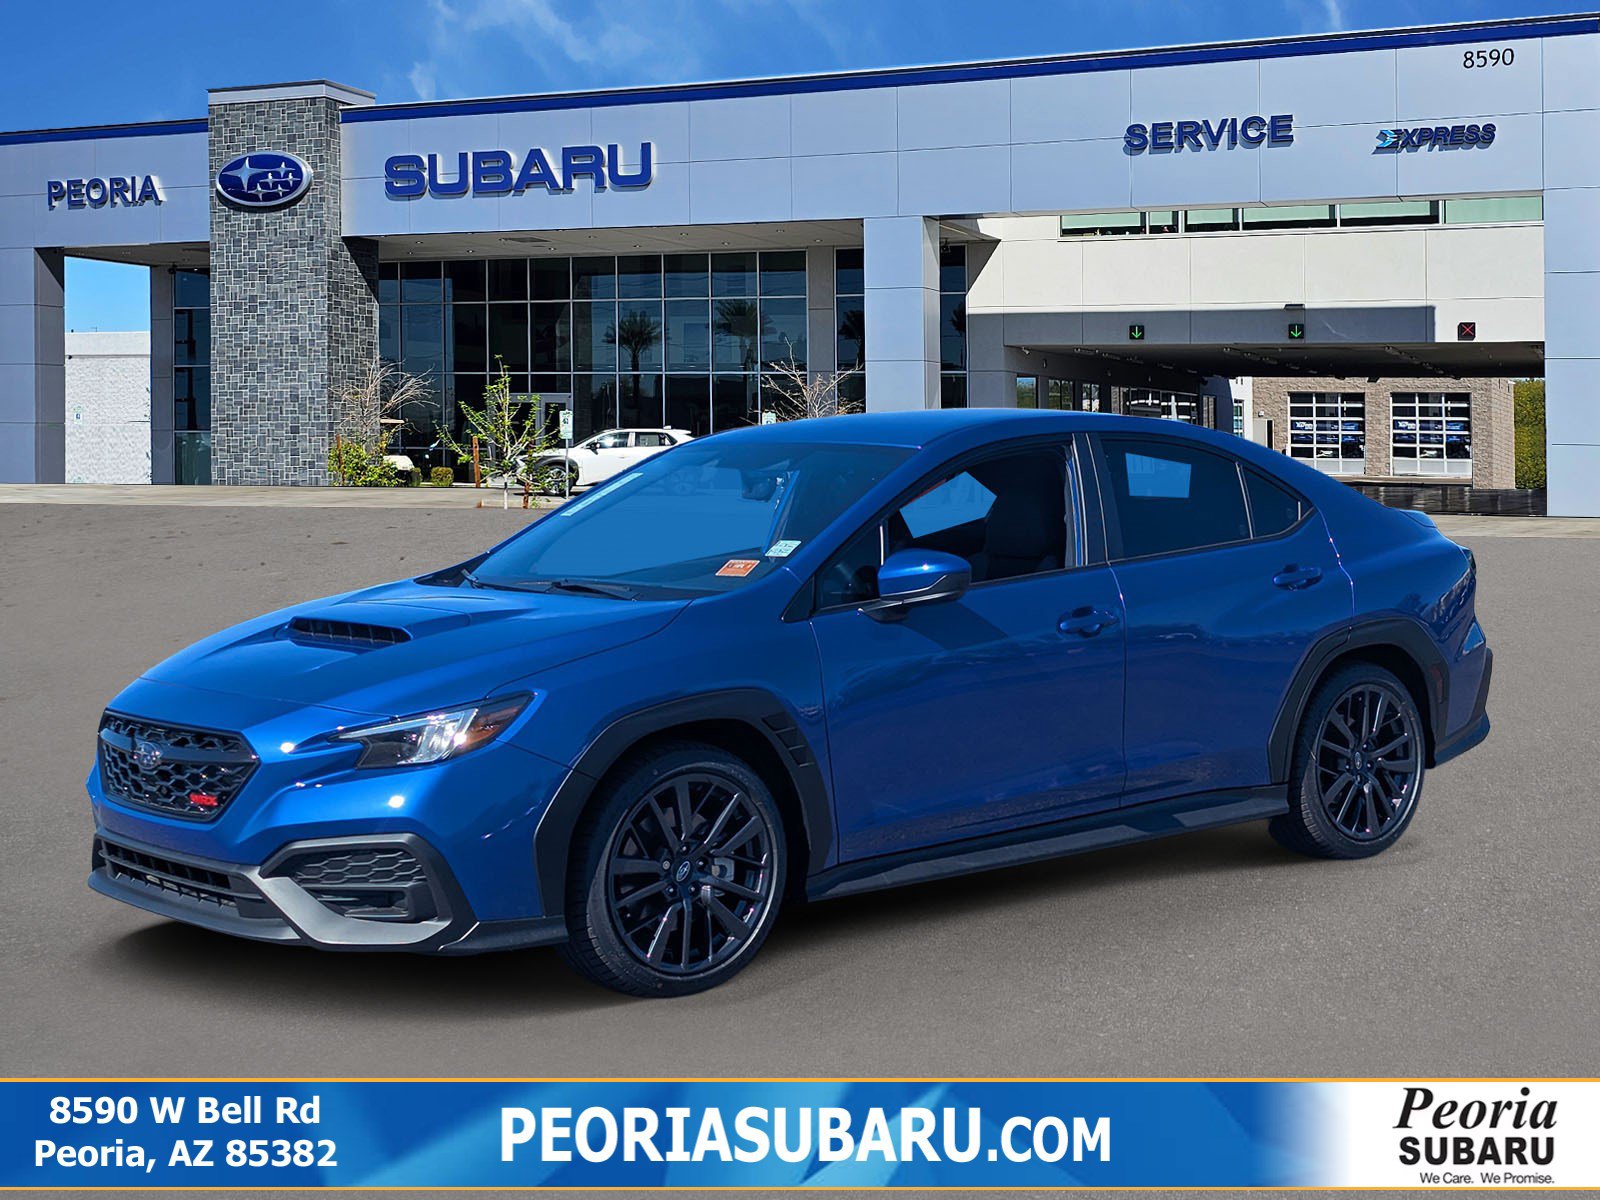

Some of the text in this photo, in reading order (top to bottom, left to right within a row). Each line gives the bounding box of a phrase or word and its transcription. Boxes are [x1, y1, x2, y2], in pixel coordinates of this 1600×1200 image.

[1462, 48, 1515, 69] 8590
[1123, 114, 1294, 152] SERVICE
[1375, 123, 1497, 151] EXPRESS
[384, 142, 653, 199] SUBARU
[47, 175, 164, 209] PEORIA
